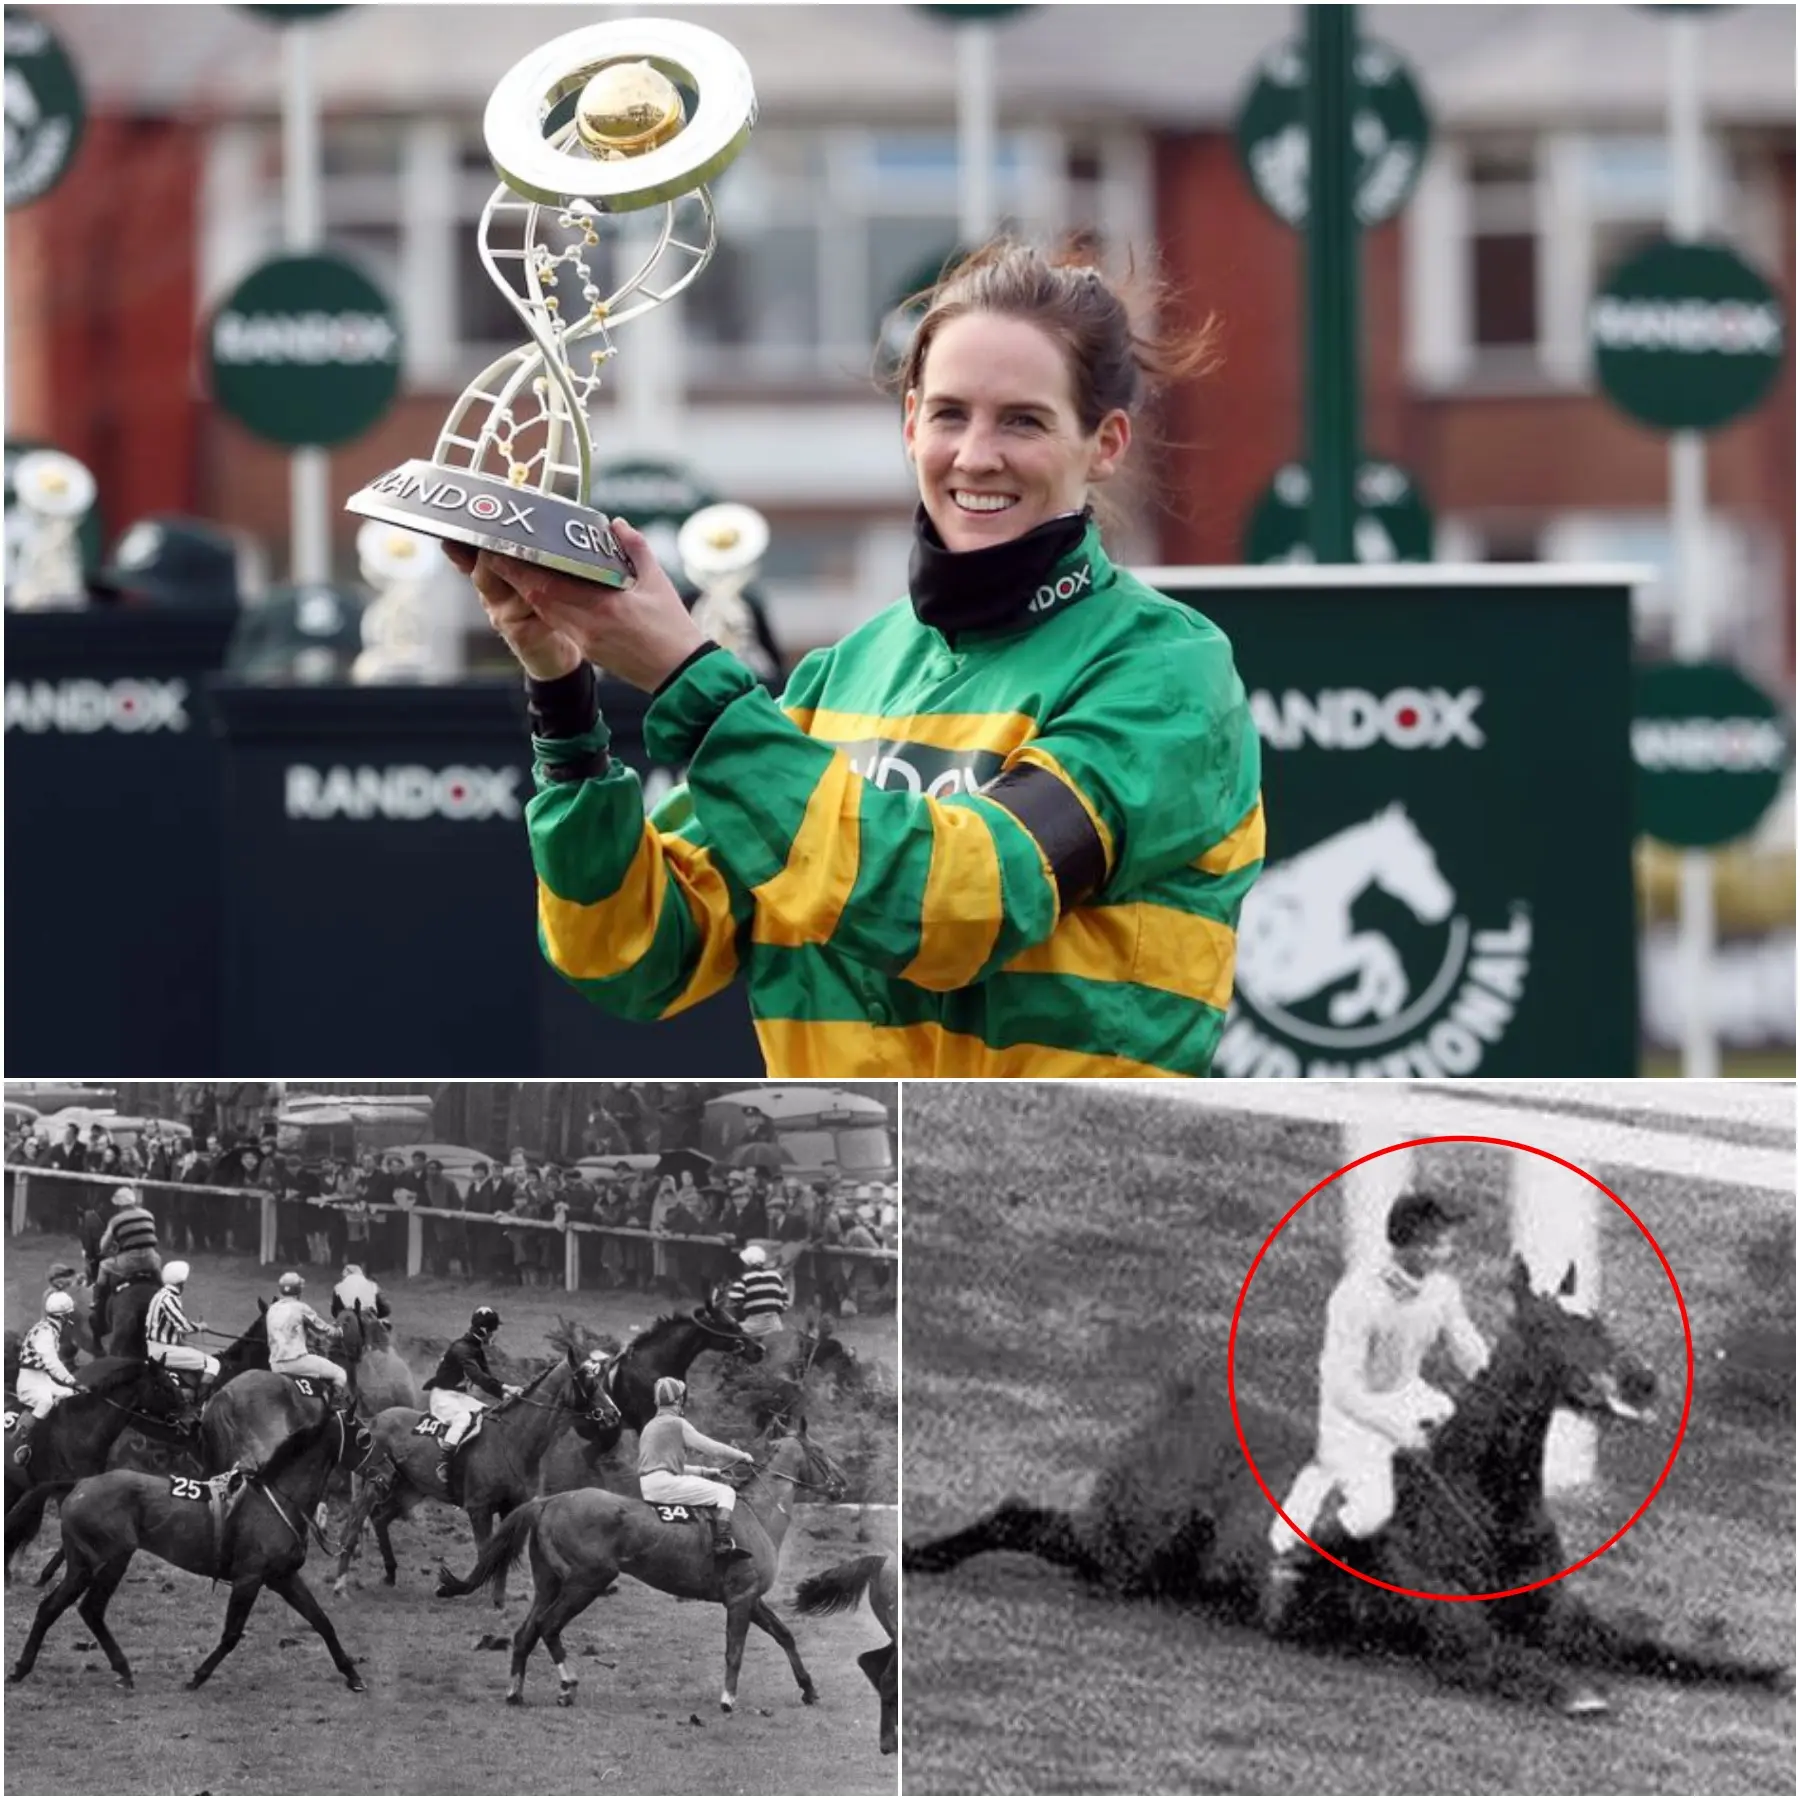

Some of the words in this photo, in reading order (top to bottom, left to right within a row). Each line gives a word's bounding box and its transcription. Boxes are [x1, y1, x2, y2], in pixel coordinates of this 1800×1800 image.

[564, 519, 622, 560] GRA
[4, 677, 190, 735] ANDOX
[1249, 687, 1487, 750] ANDOX
[284, 764, 519, 821] RANDOX
[295, 1379, 314, 1396] 13
[171, 1476, 201, 1500] 25
[657, 1505, 689, 1521] 34
